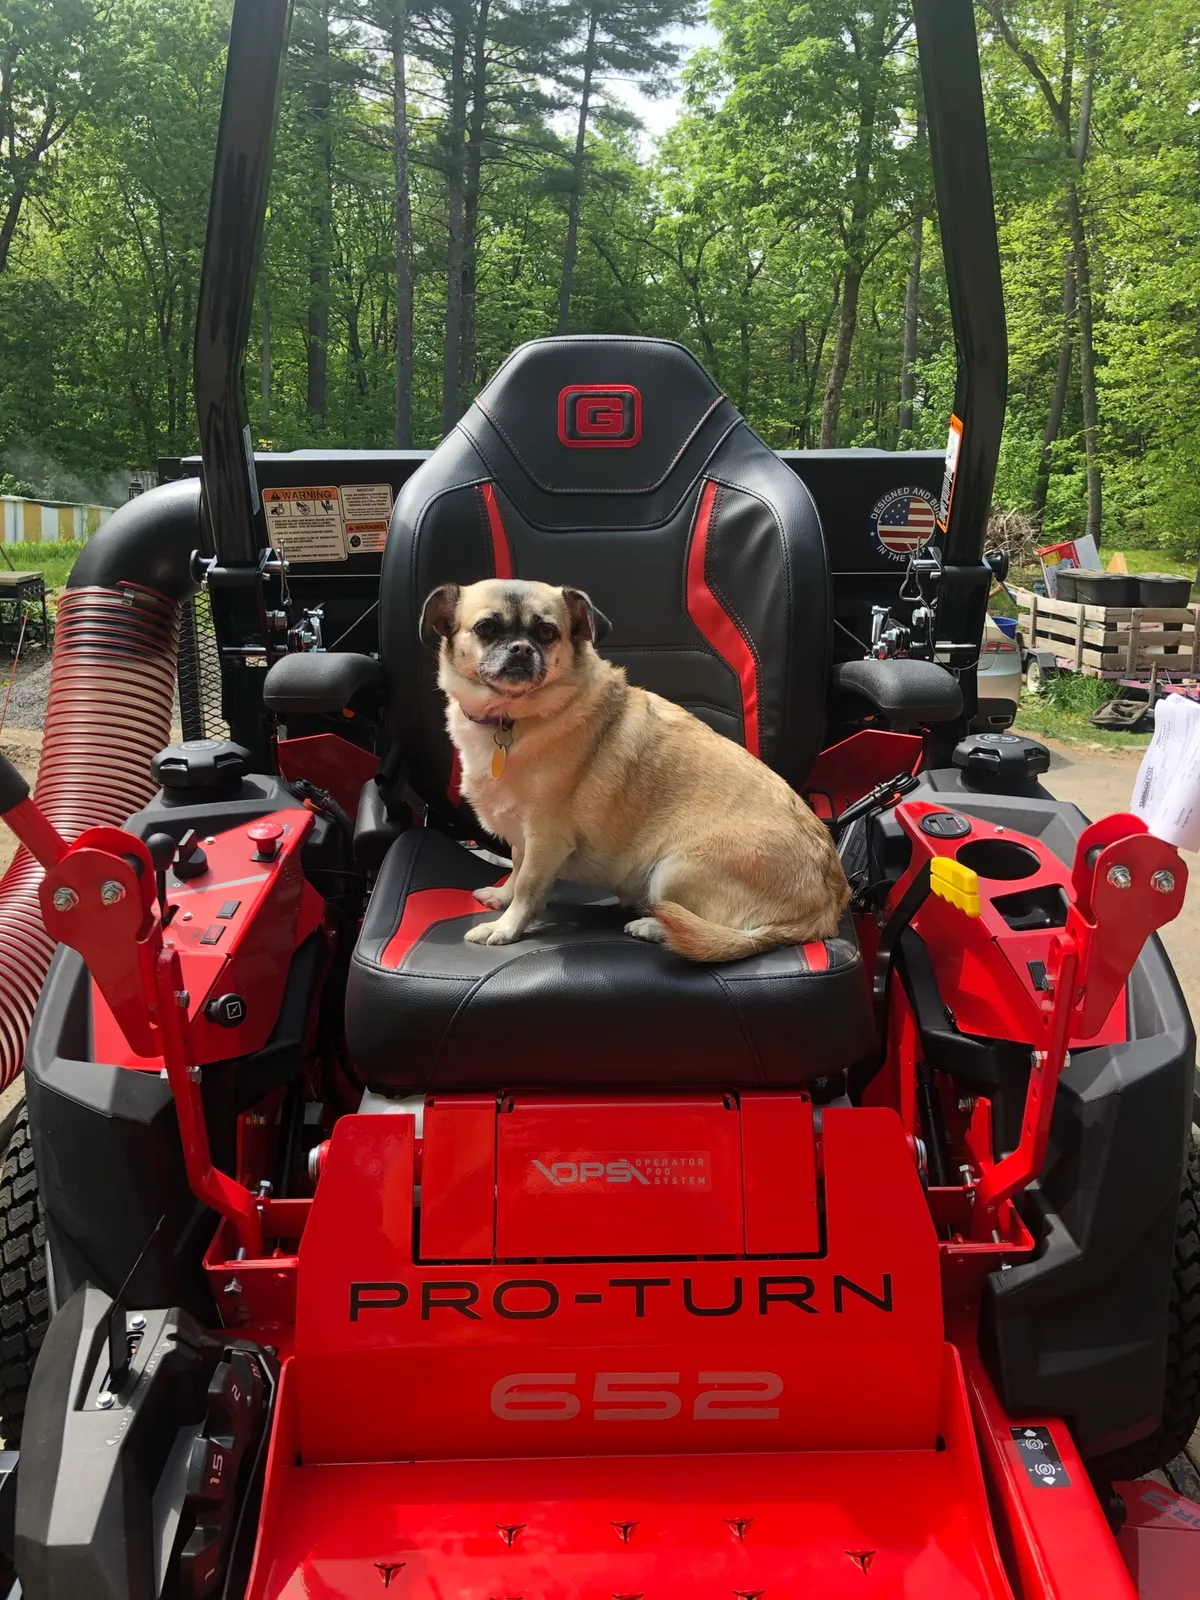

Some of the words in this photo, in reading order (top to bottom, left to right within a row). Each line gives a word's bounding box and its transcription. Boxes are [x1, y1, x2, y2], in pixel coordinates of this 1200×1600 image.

[282, 489, 332, 500] WARNING
[870, 487, 911, 520] DESIGNED
[912, 487, 931, 501] AND
[876, 544, 888, 555] IN
[887, 551, 906, 562] THE
[635, 1158, 705, 1167] OPERATOR
[646, 1167, 671, 1176] POD
[655, 1177, 706, 1185] SYSTEM
[349, 1272, 893, 1322] PRO-TURN
[490, 1371, 784, 1421] 652
[209, 1454, 224, 1484] 1.5
